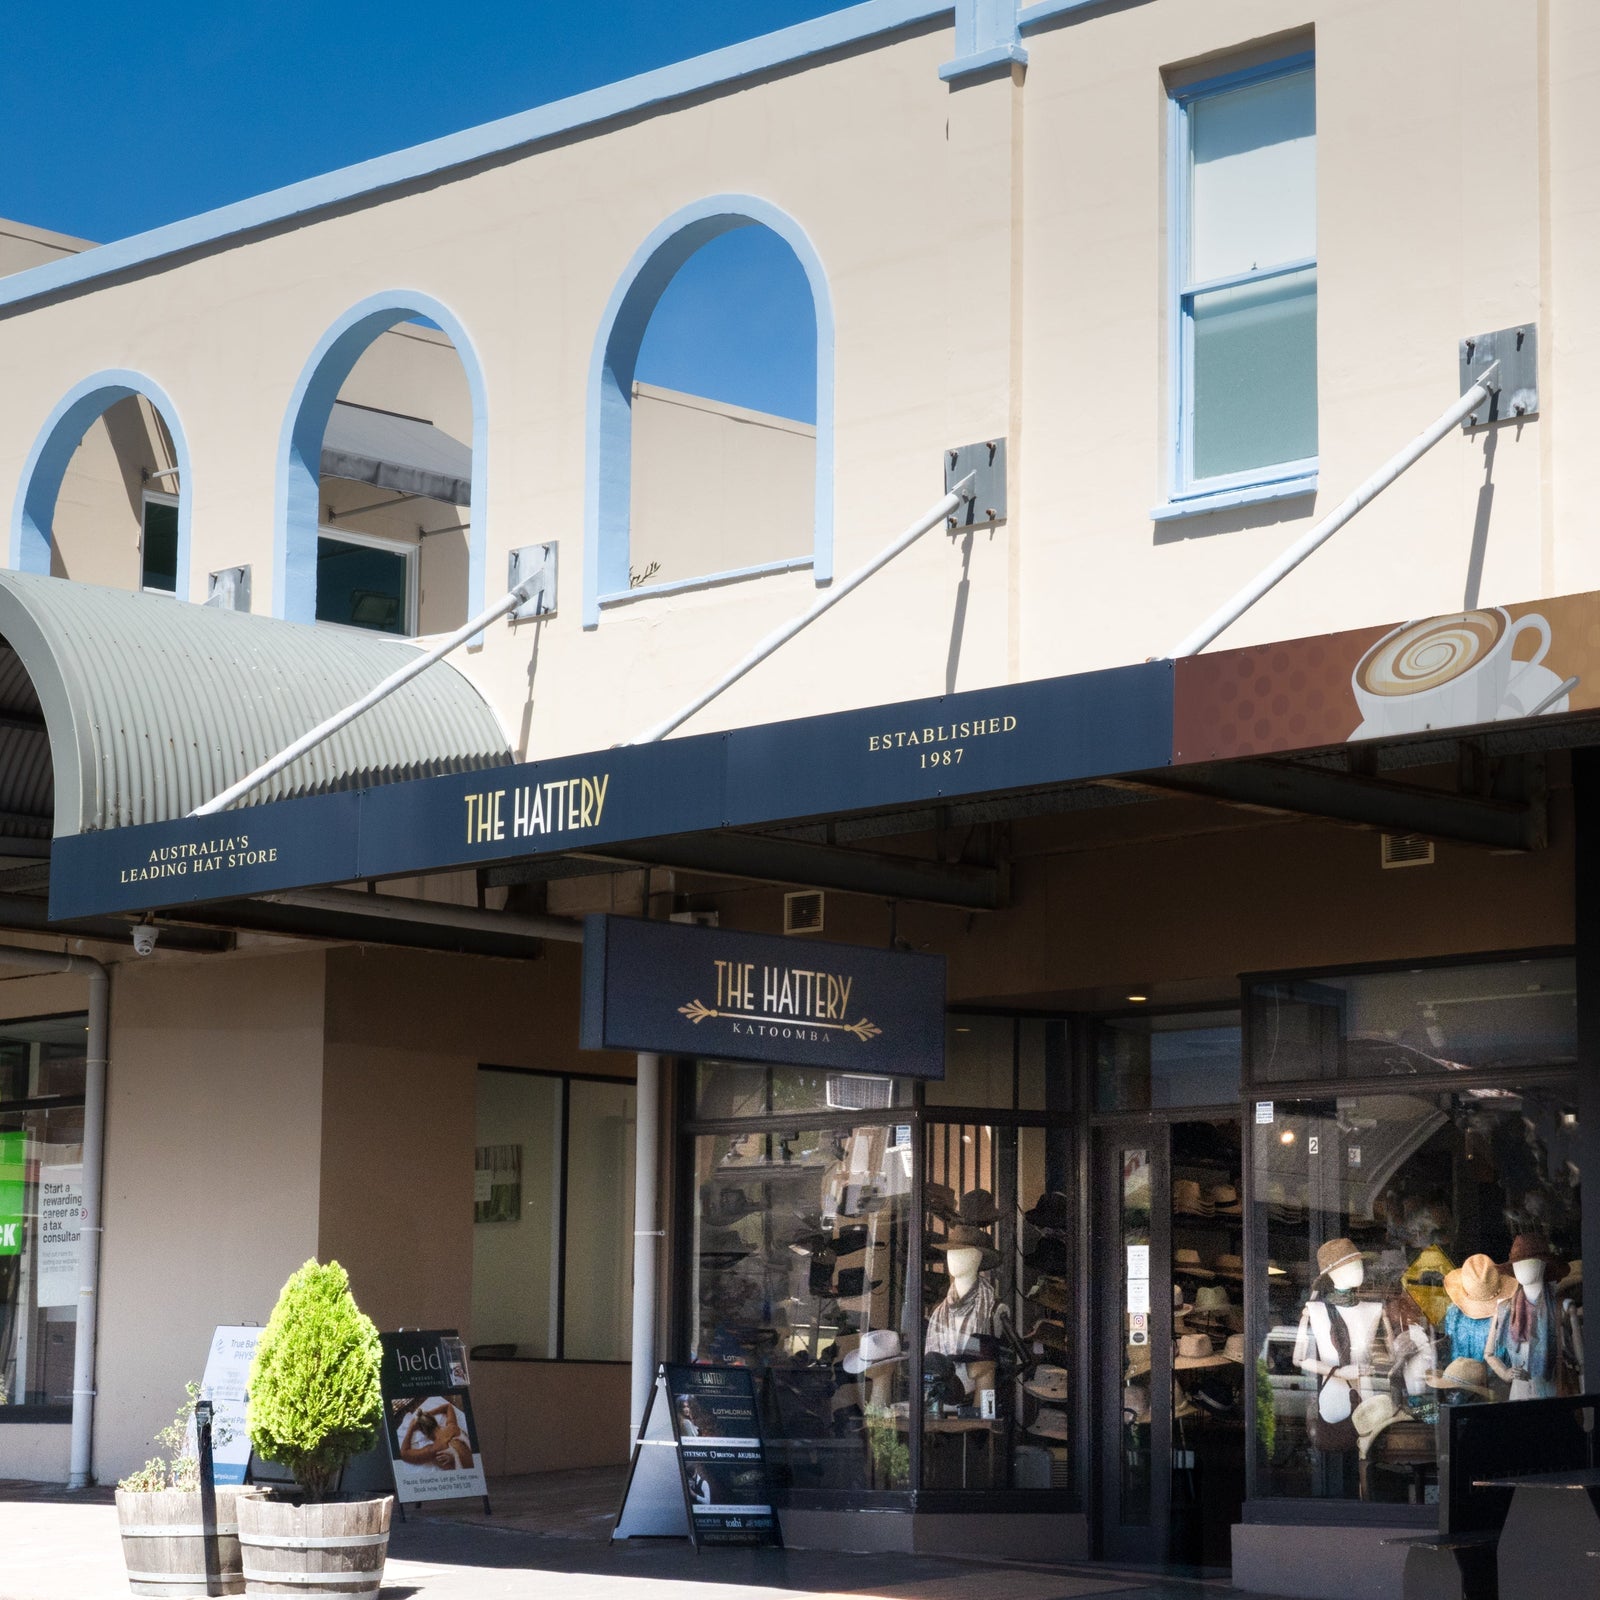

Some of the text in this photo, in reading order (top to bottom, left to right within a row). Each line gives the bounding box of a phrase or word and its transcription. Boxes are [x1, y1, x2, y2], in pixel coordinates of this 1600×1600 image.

[869, 716, 1017, 751] ESTABLISHED
[920, 748, 964, 769] 1987
[464, 773, 609, 844] THE HATTERY
[149, 835, 249, 862] AUSTRALIA'S
[121, 848, 278, 883] LEADING HAT STORE
[713, 960, 852, 1020] THE HATTERY
[733, 1022, 831, 1042] KATOOMBA
[1310, 1140, 1317, 1152] 2
[44, 1183, 71, 1194] Start a
[43, 1194, 82, 1206] rewarding
[43, 1208, 79, 1219] career as
[43, 1221, 62, 1231] a tax
[43, 1231, 81, 1243] consultan
[396, 1346, 442, 1371] held
